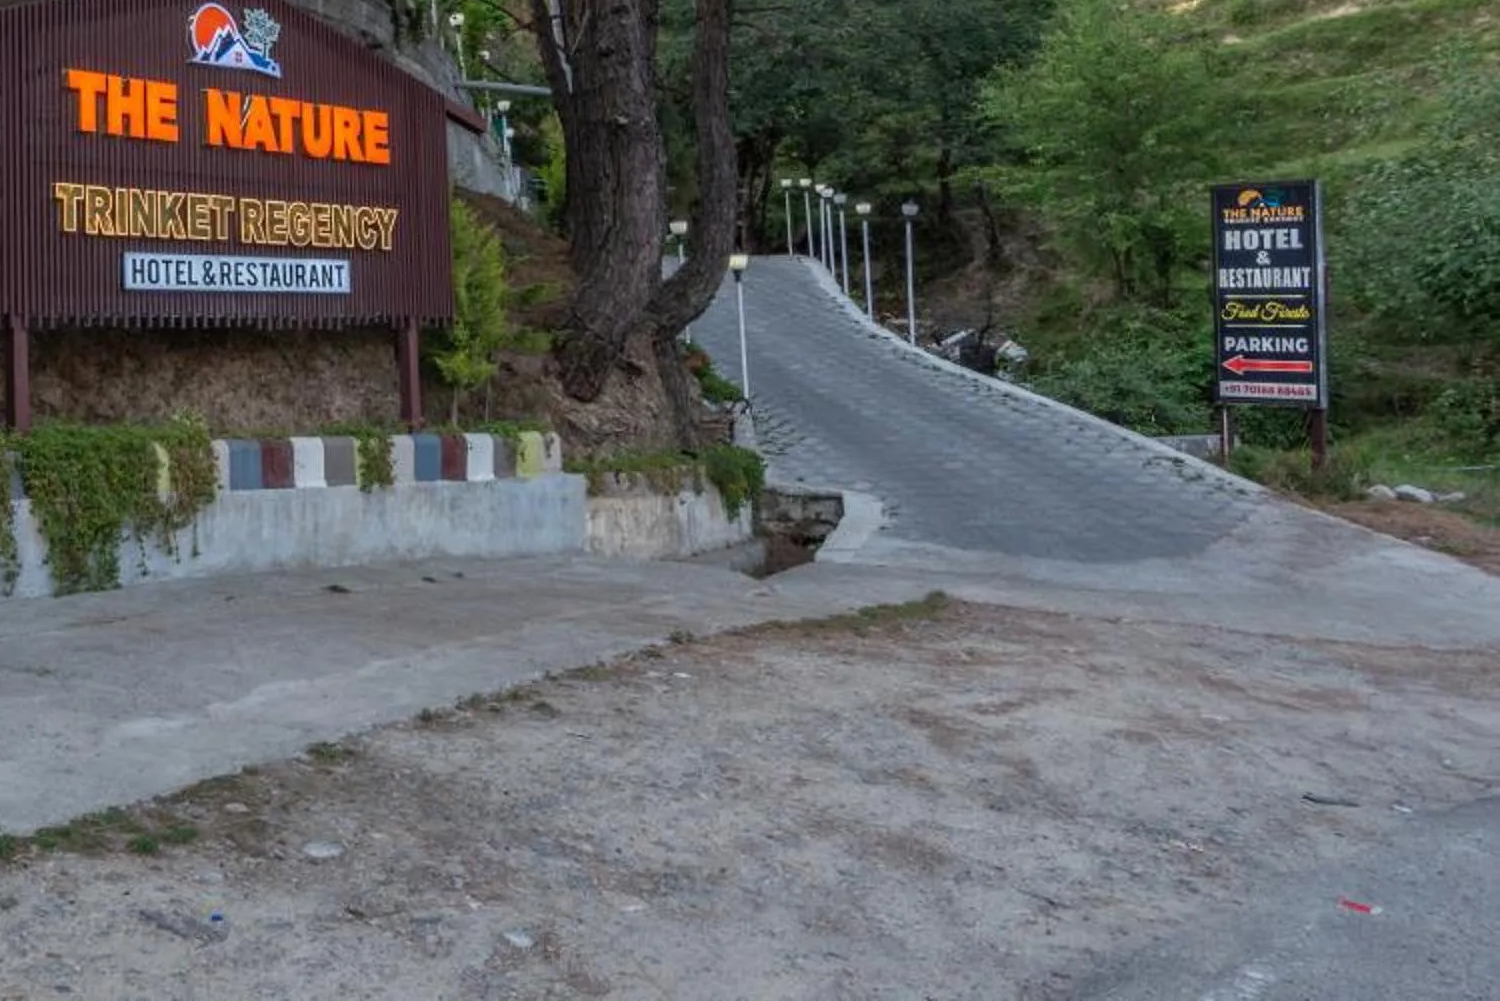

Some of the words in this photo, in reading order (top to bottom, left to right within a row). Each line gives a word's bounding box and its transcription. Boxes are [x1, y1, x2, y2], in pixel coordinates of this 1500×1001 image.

[67, 69, 179, 142] THE
[205, 87, 390, 164] NATURE
[54, 182, 236, 240] TRINKET
[240, 198, 398, 251] REGENCY
[1223, 207, 1248, 218] THE
[1251, 205, 1303, 217] NATURE
[1225, 228, 1303, 250] HOTEL
[1256, 251, 1271, 265] &
[1219, 267, 1311, 288] RESTAURANT
[1224, 336, 1309, 353] PARKING
